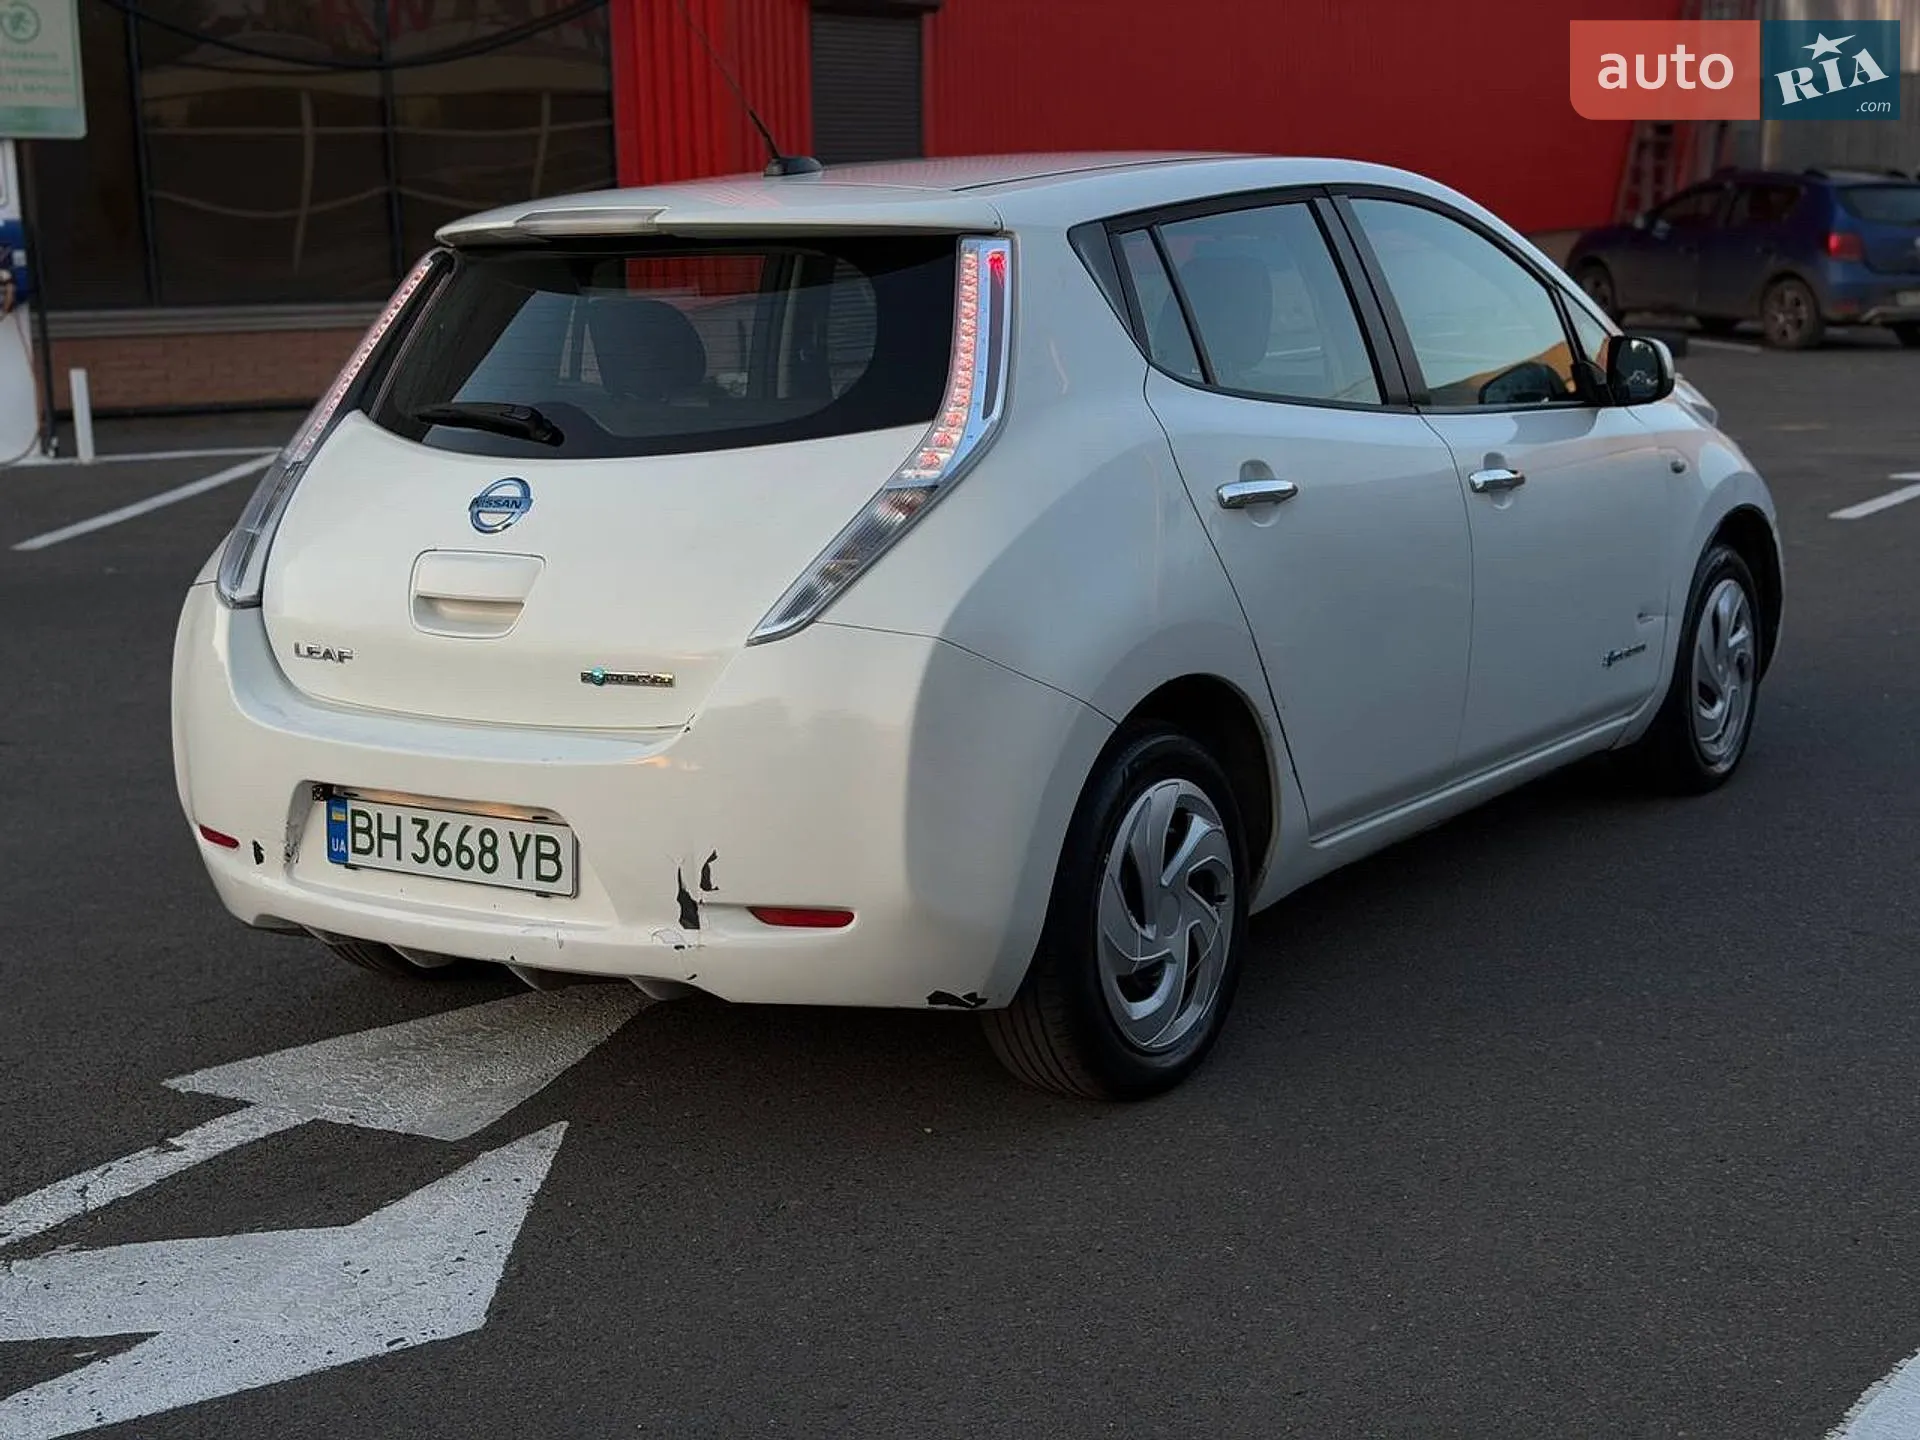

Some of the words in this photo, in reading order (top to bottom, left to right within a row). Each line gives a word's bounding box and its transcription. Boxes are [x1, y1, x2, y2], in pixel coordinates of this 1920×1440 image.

[294, 642, 354, 664] LEAF
[331, 837, 346, 853] UA
[411, 817, 499, 875] 3668
